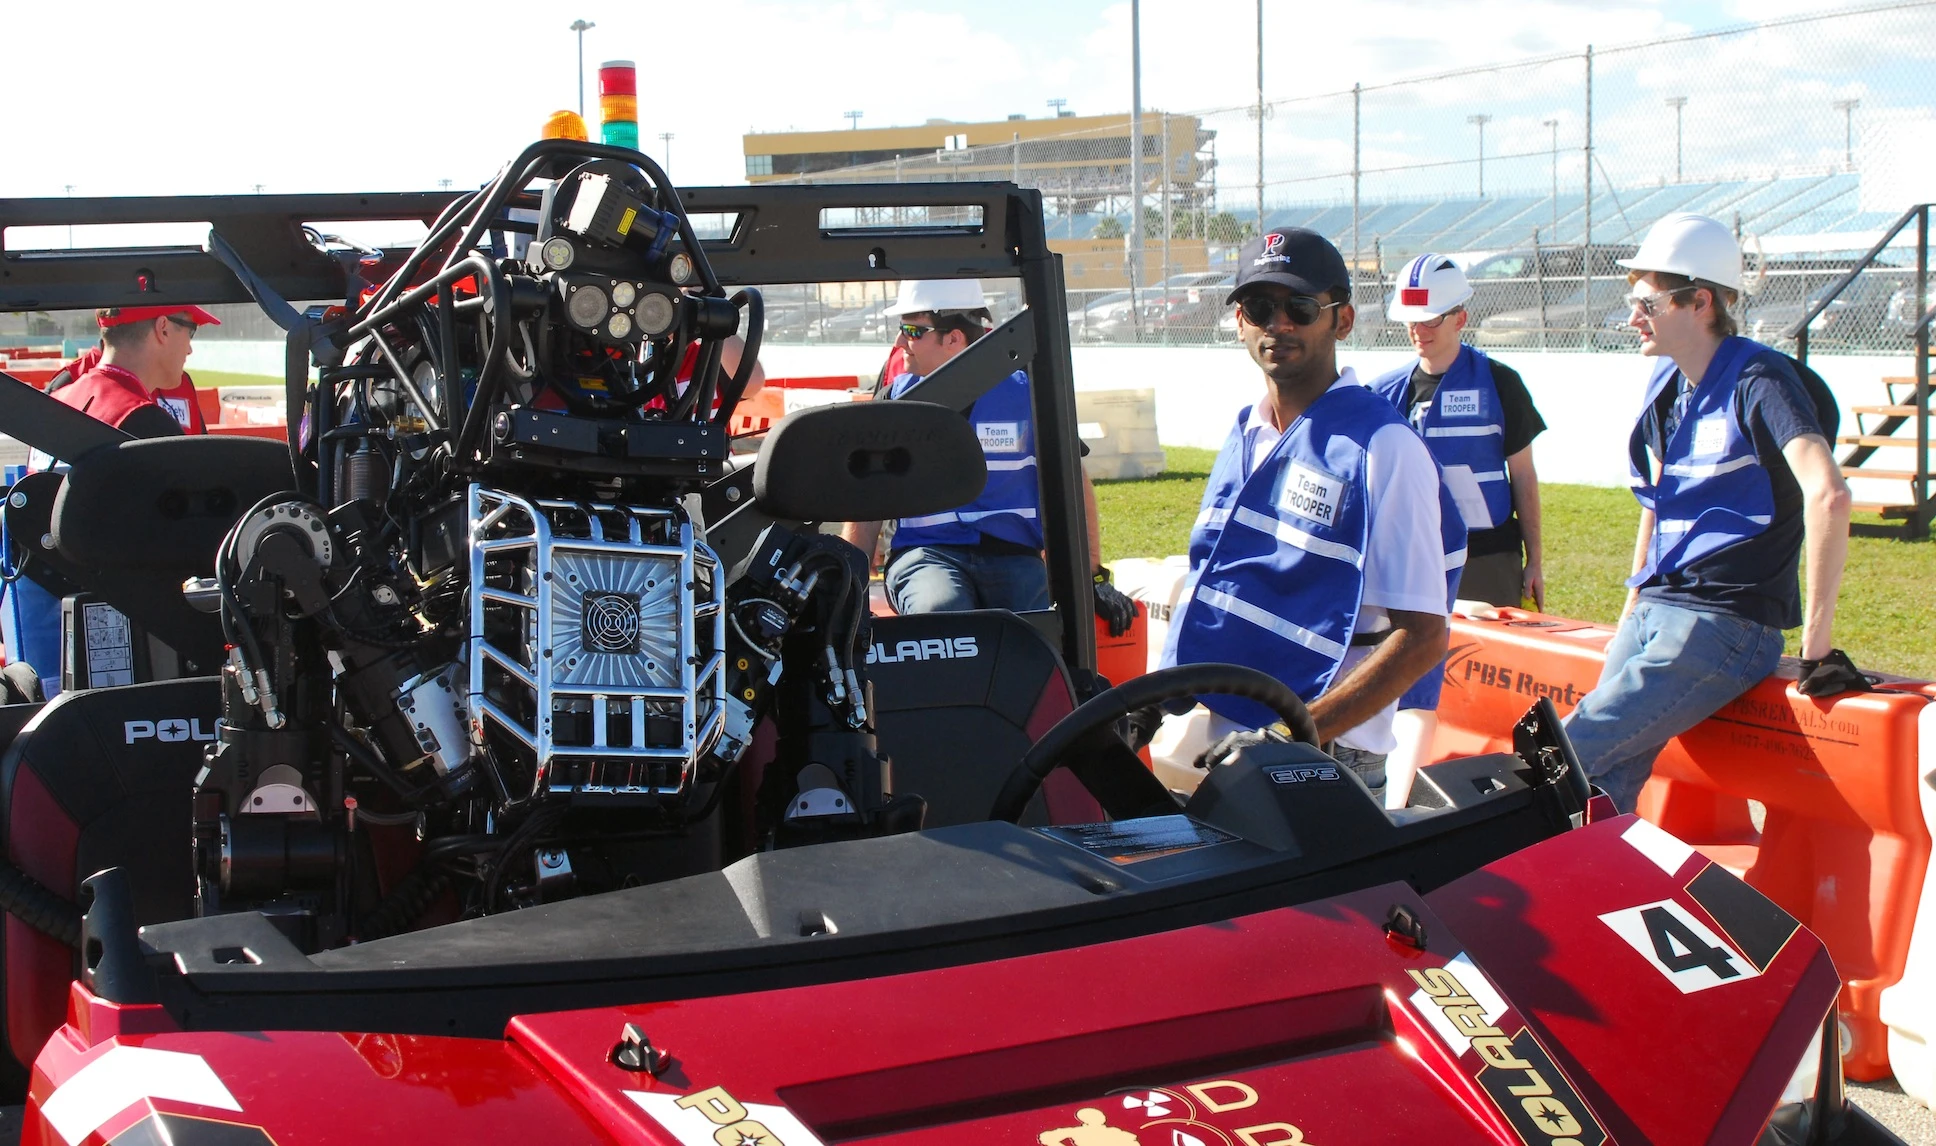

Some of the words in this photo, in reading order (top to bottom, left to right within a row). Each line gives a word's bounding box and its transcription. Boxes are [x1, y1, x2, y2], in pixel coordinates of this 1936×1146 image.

[1444, 403, 1476, 413] TROOPER
[1450, 394, 1471, 402] Team
[980, 437, 1015, 447] TROOPER
[985, 427, 1009, 436] Team
[1298, 473, 1328, 498] Team
[1285, 489, 1332, 520] TROOPER
[1464, 660, 1513, 690] PBS
[1270, 767, 1340, 784] EPS
[1640, 906, 1741, 980] 4
[1407, 967, 1584, 1146] OLARIS
[1183, 1080, 1259, 1114] D
